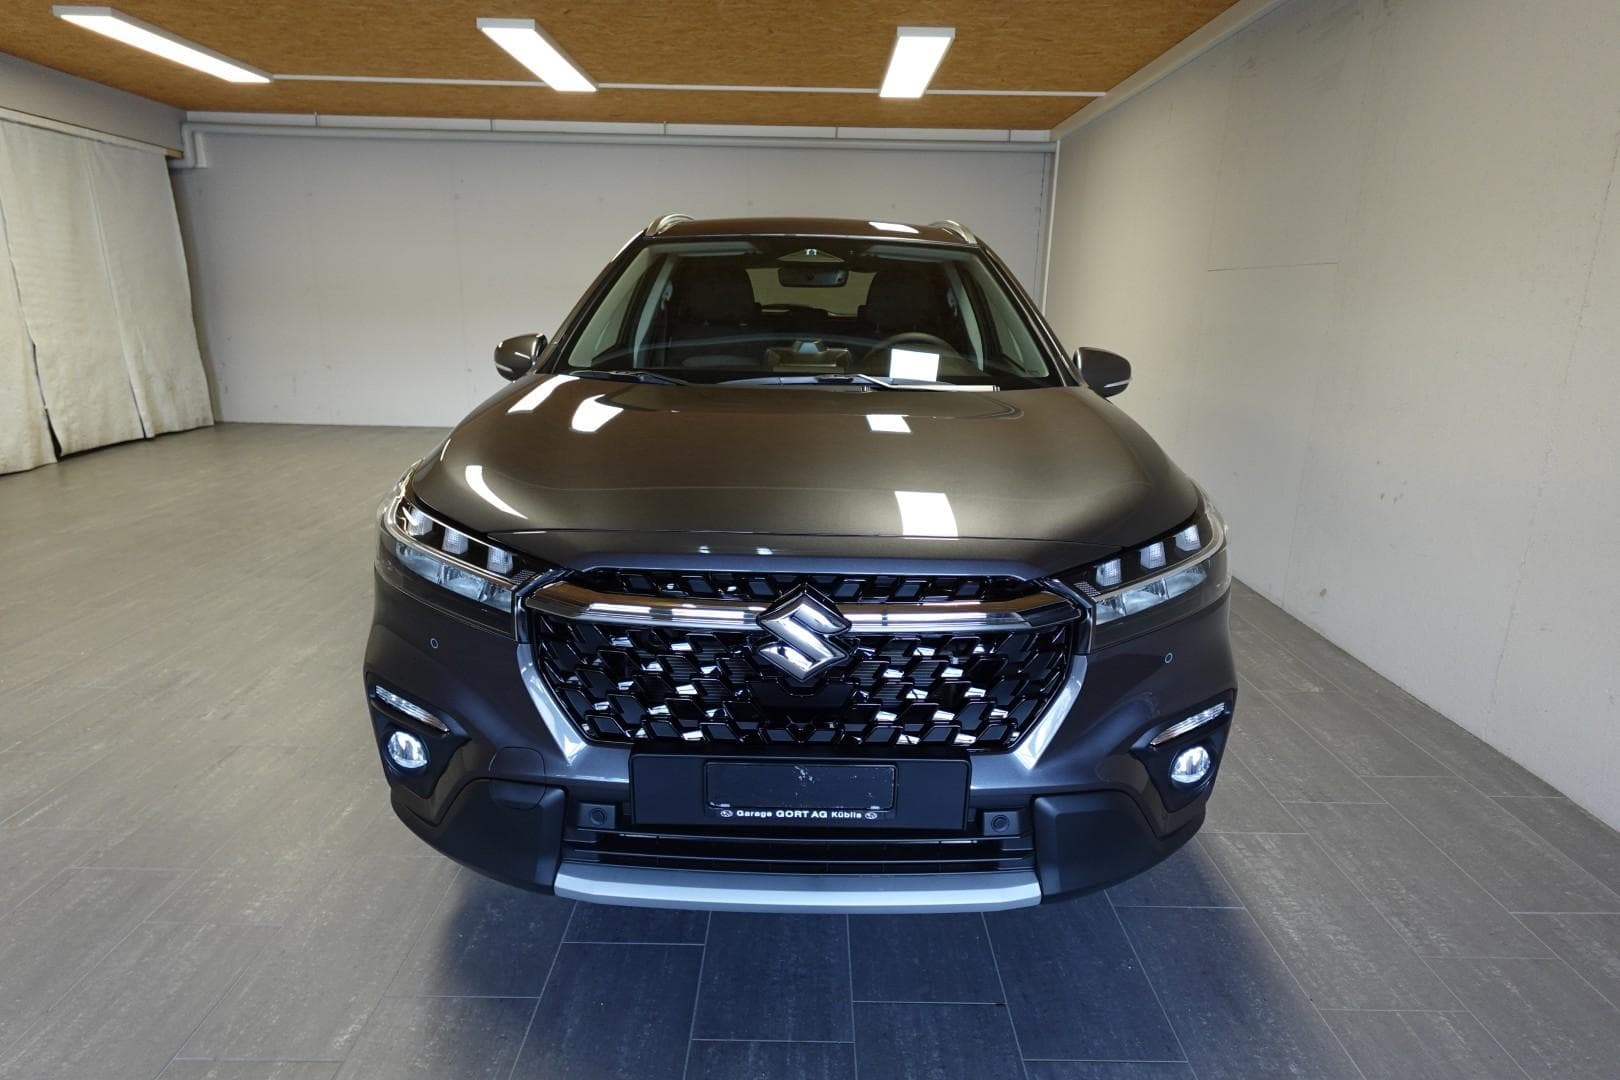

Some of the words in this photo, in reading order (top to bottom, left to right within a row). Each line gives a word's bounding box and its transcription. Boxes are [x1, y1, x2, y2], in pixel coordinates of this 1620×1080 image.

[736, 810, 773, 818] Garage
[776, 810, 809, 818] GORT
[811, 810, 828, 819] AG
